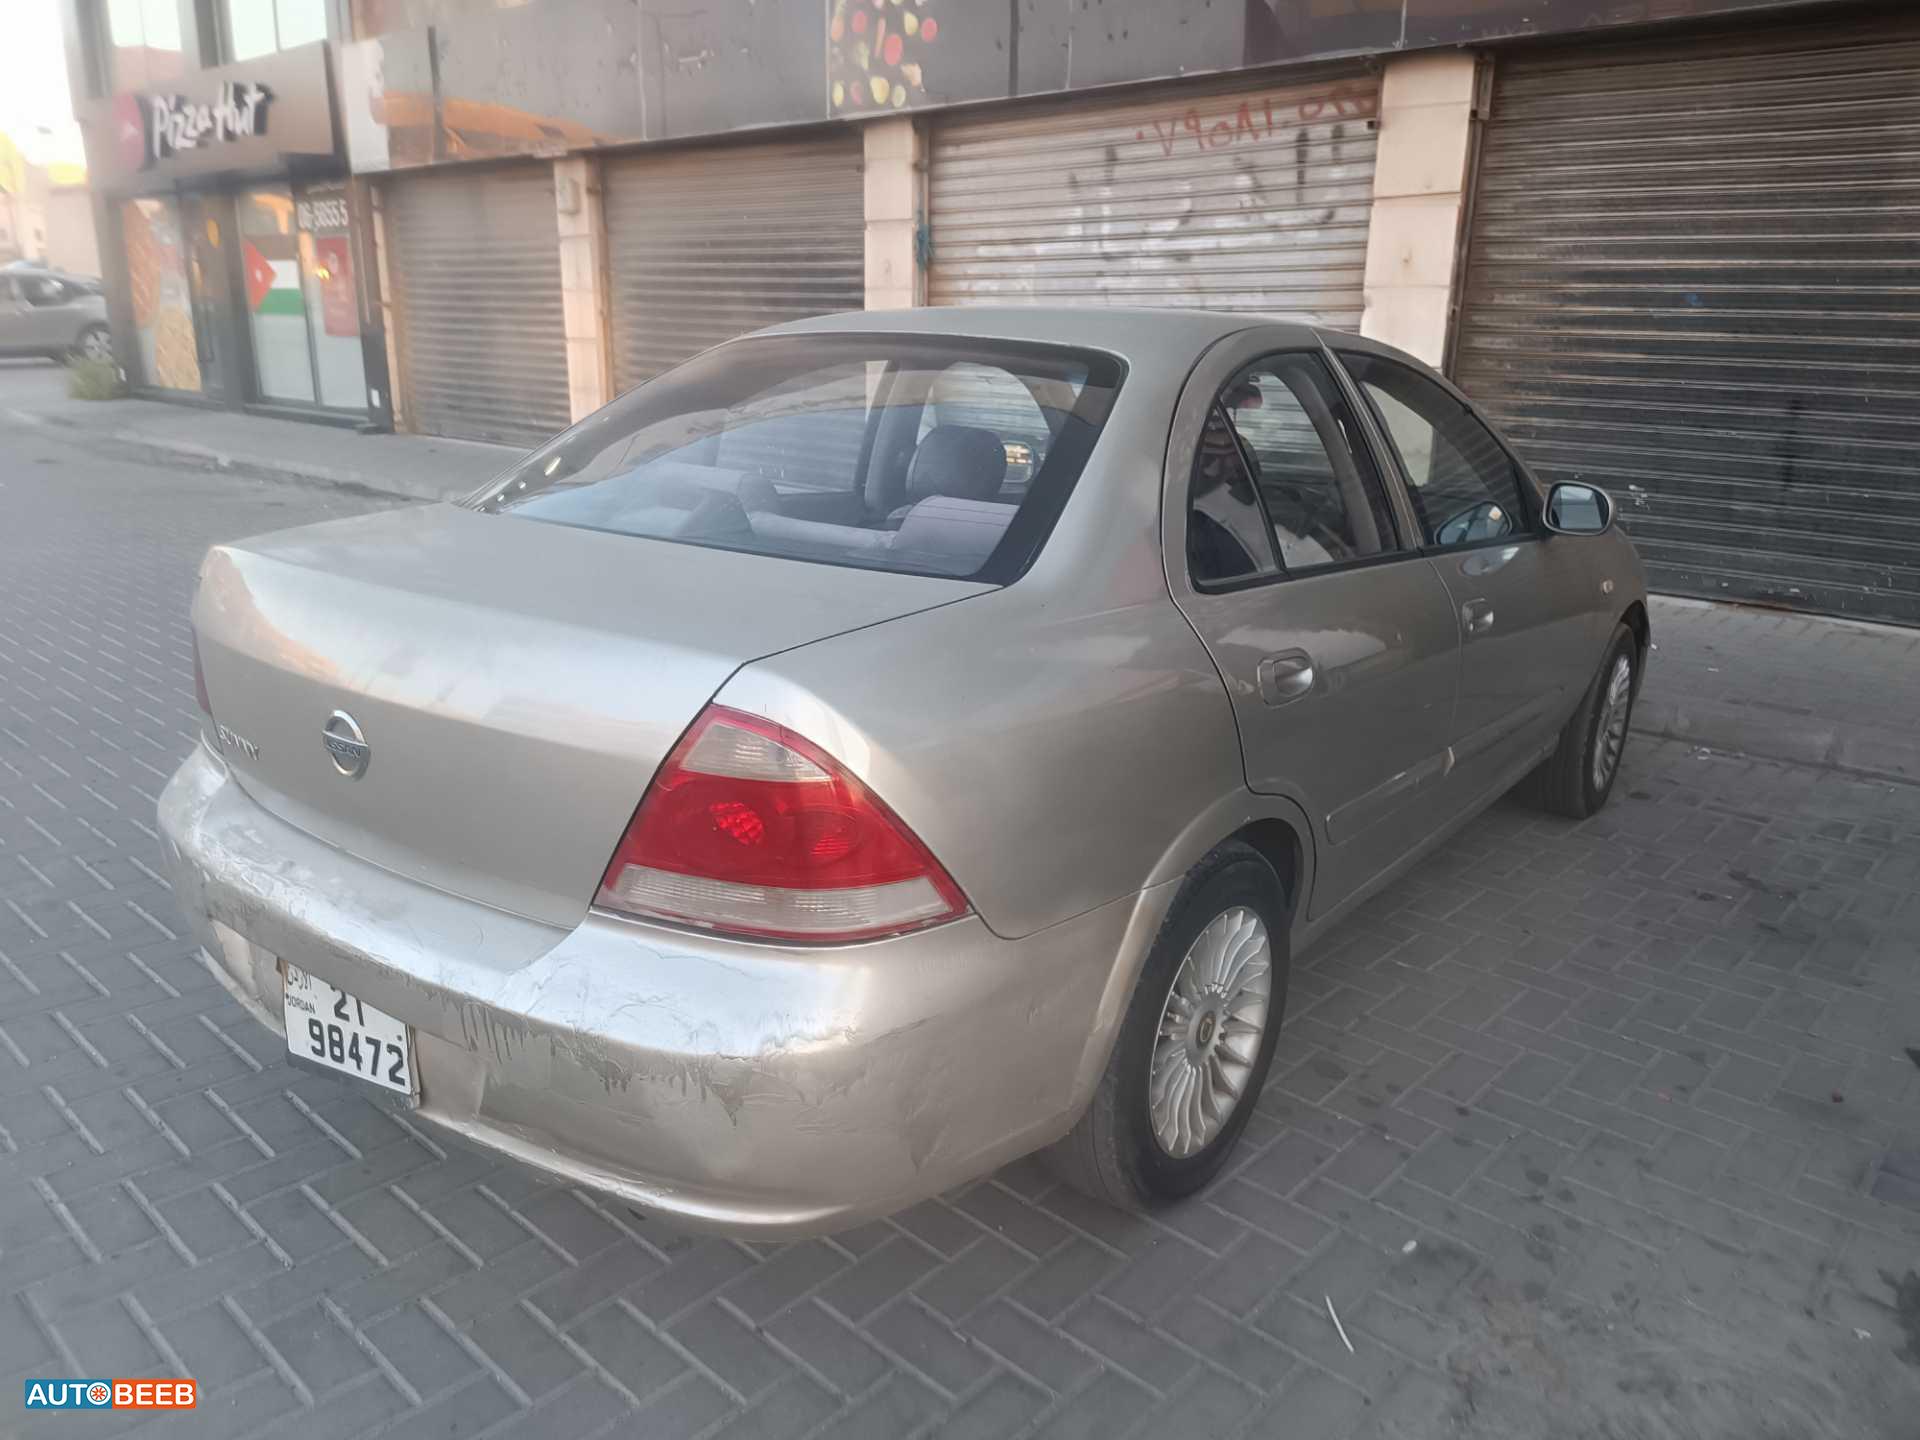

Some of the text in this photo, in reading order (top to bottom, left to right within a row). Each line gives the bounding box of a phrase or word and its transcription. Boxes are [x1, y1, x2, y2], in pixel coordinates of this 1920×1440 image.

[151, 82, 265, 160] Pizza Hut
[288, 994, 316, 1014] JORDAN
[308, 1018, 406, 1086] 98472
